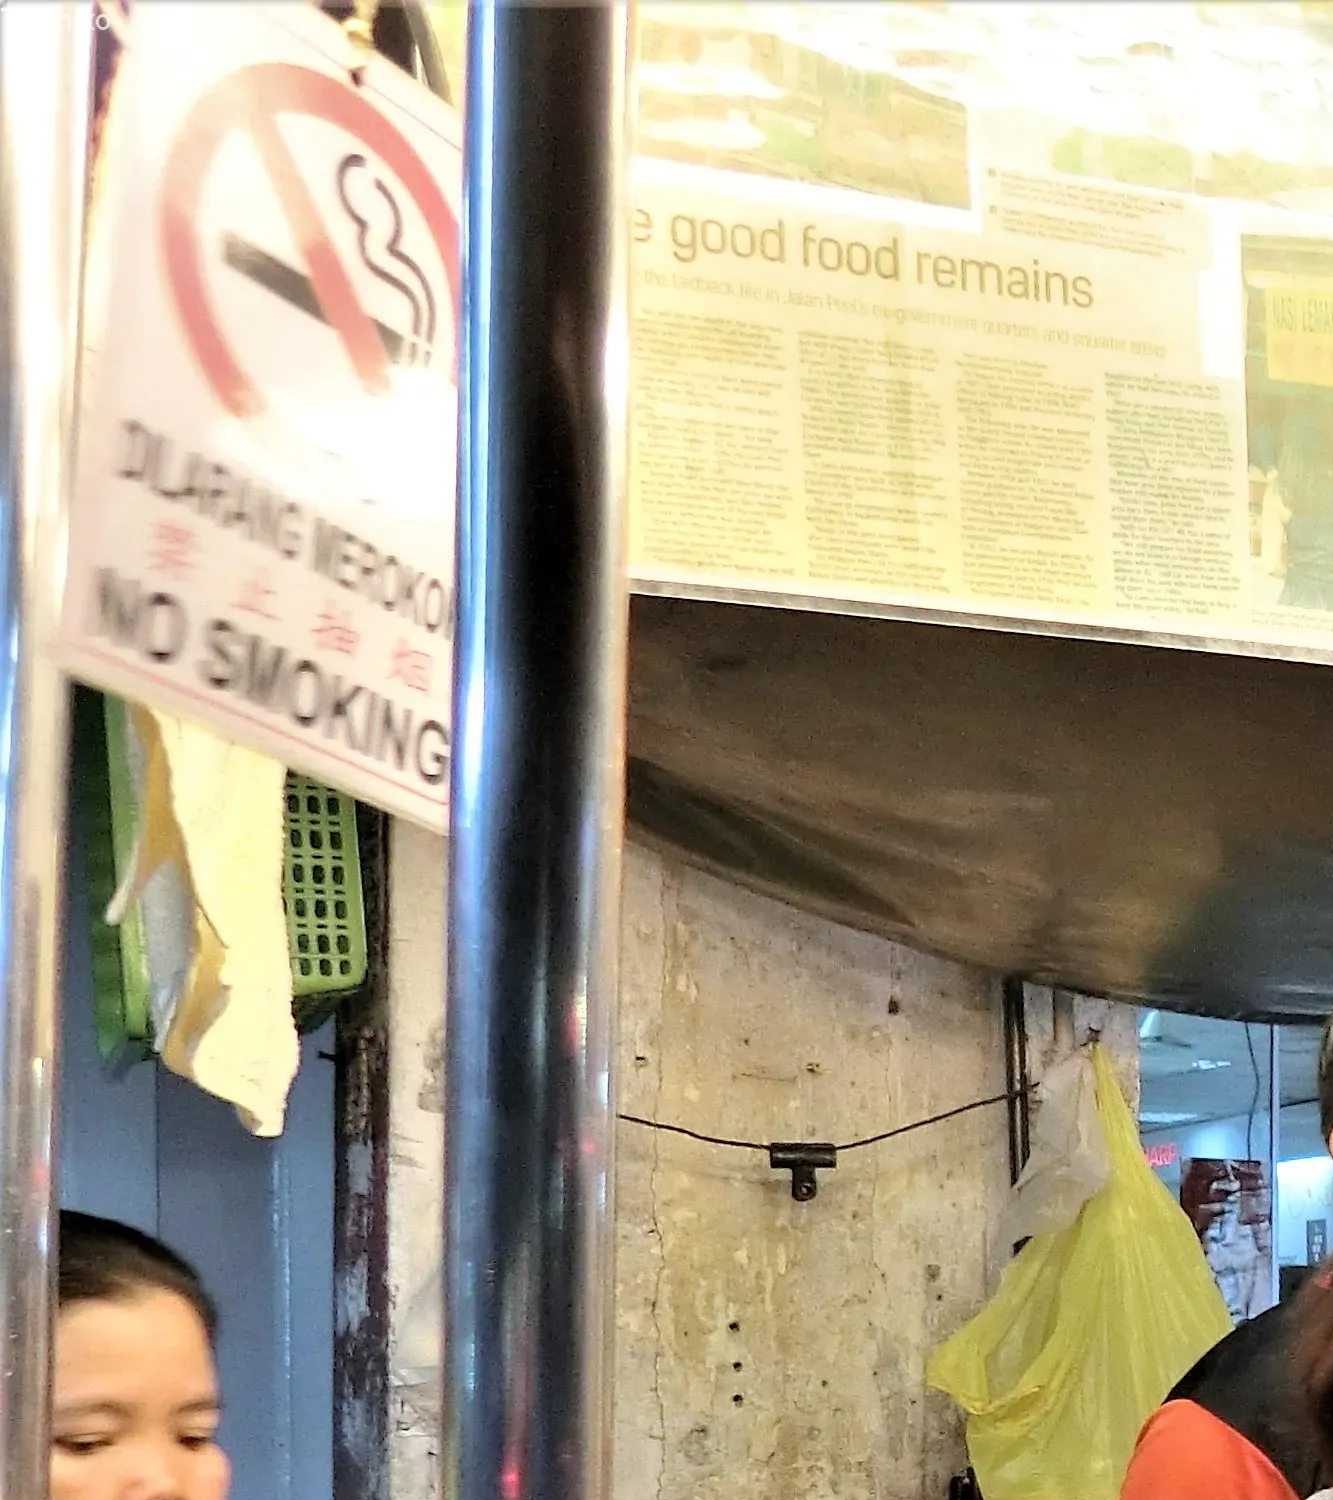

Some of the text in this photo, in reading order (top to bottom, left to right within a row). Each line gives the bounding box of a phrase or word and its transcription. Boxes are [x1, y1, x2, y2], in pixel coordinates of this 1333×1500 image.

[671, 214, 787, 263] good
[801, 224, 900, 282] food
[917, 249, 1095, 309] remains
[312, 516, 454, 641] MEROKO
[92, 564, 453, 786] NO SMOKING
